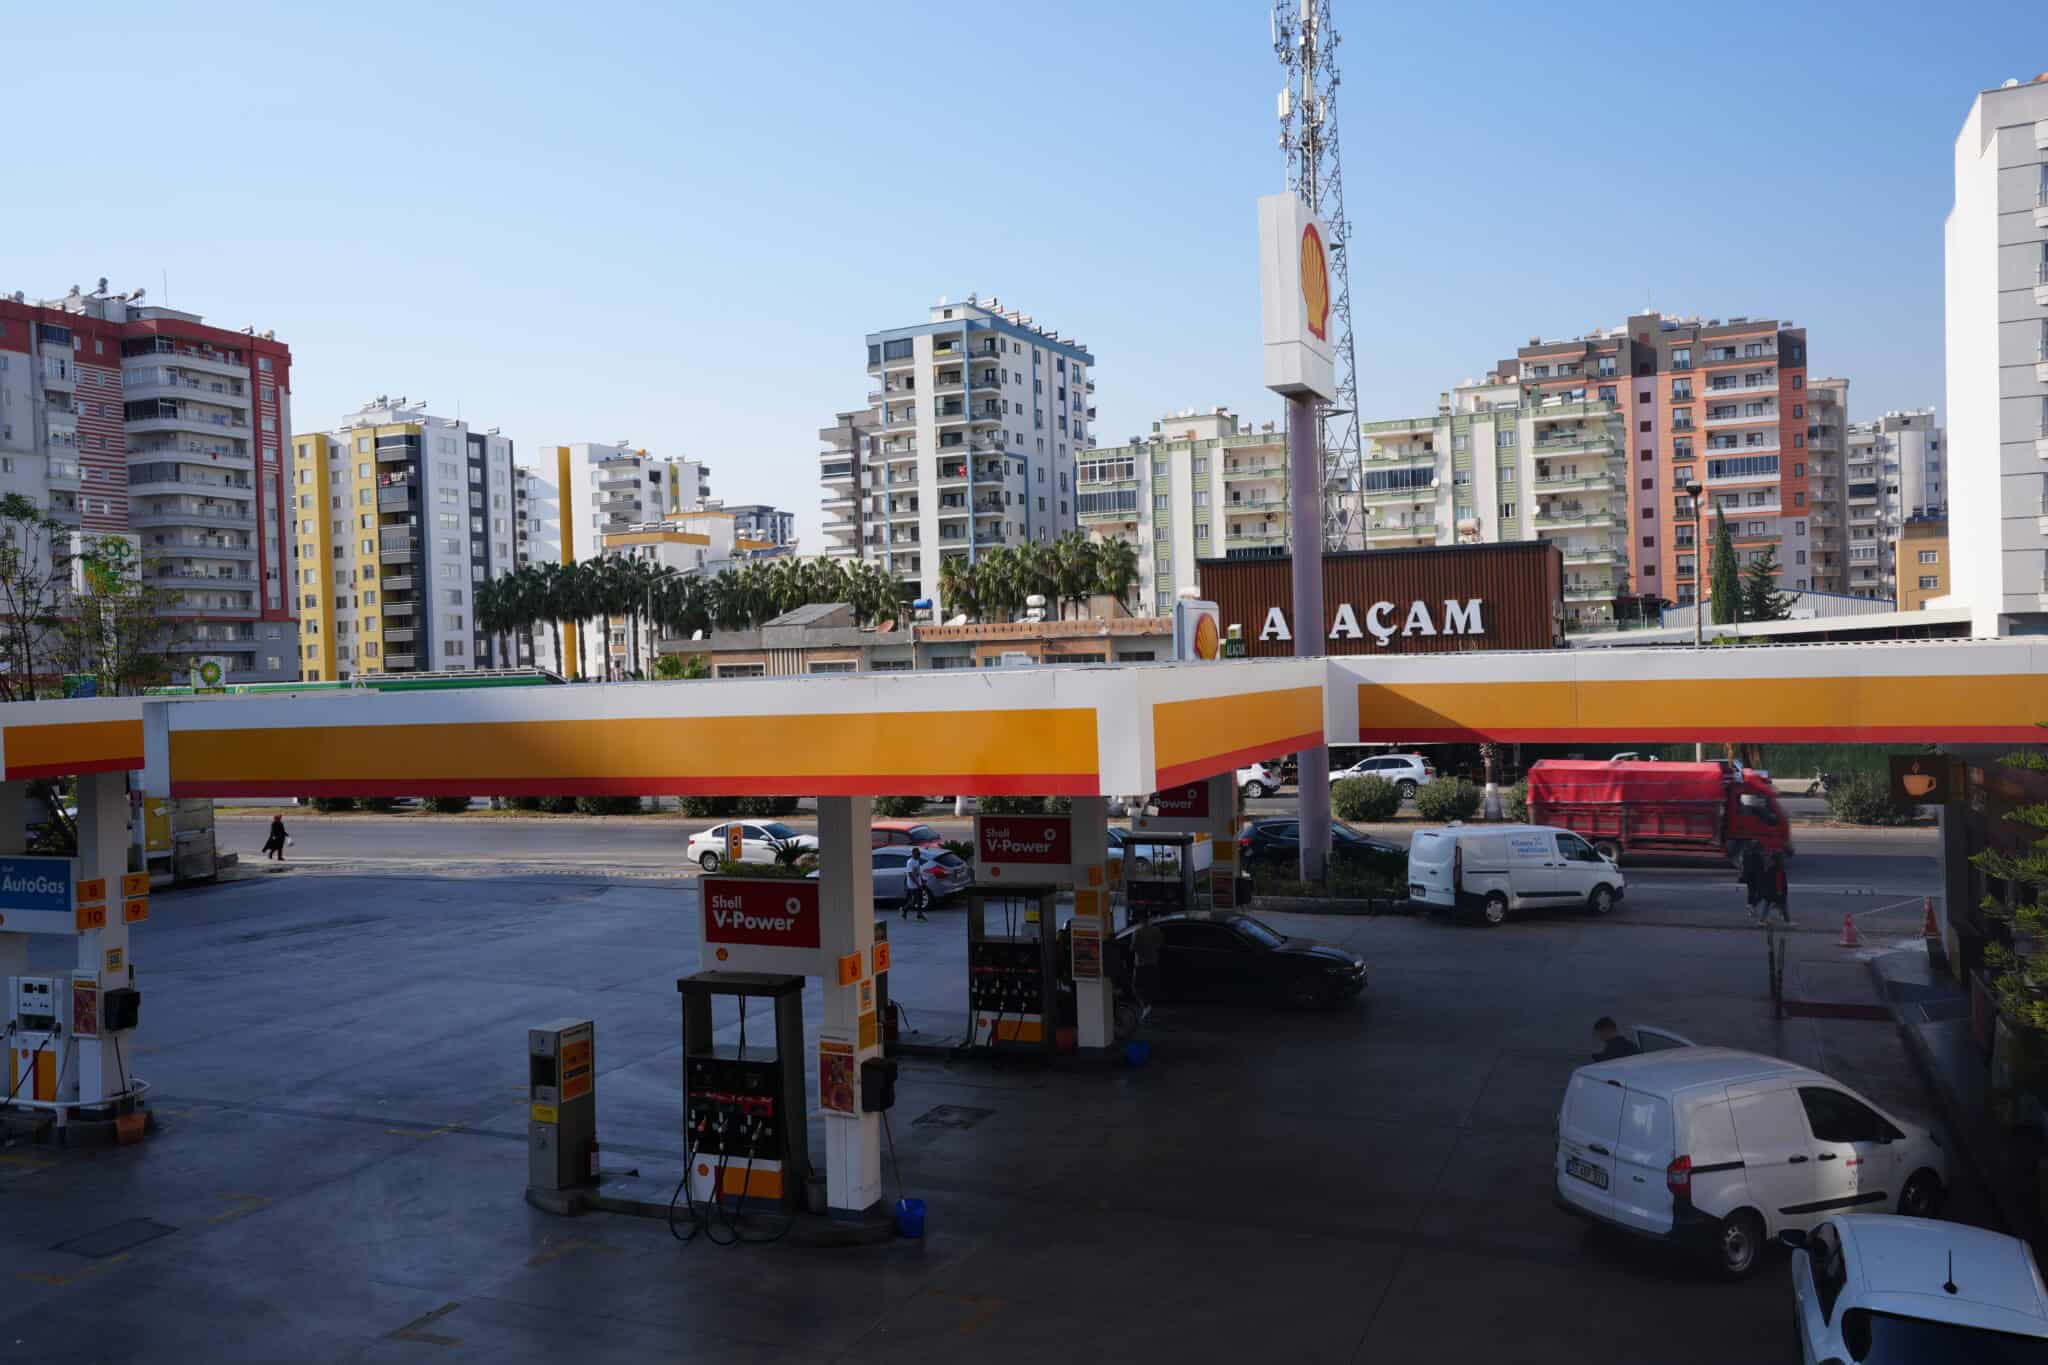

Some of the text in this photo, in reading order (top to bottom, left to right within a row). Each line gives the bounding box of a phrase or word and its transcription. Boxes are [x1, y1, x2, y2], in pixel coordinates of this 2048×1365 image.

[1259, 599, 1485, 646] AAÇAM
[985, 827, 1010, 838] Shell
[986, 838, 1051, 853] V-Power
[1, 874, 65, 894] AutoGas
[131, 903, 141, 916] 9
[711, 895, 743, 909] Shell
[88, 910, 103, 924] 10
[713, 910, 795, 932] V-Power
[879, 950, 887, 966] 5
